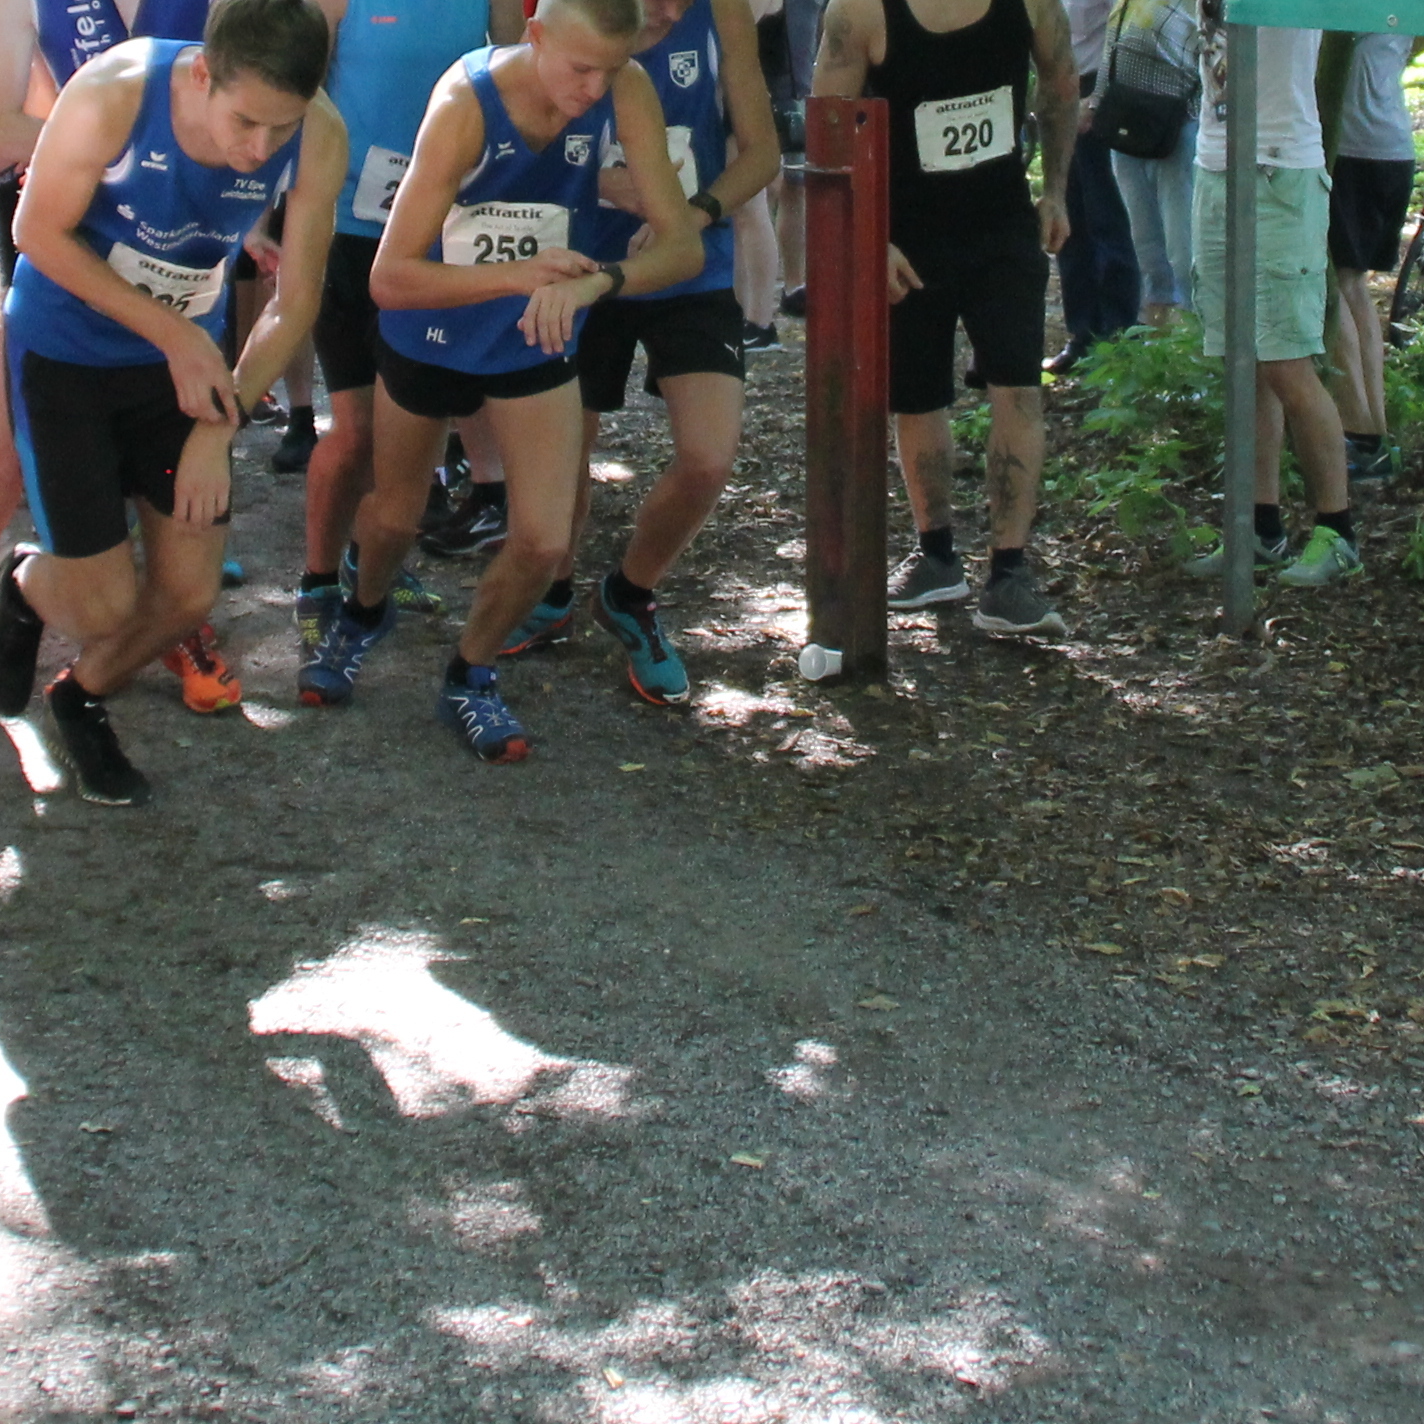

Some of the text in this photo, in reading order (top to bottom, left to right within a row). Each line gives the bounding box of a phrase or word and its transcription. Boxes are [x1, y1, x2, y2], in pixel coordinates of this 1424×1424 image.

[936, 95, 995, 114] attractic
[942, 118, 993, 157] 220
[473, 234, 539, 264] 259
[425, 327, 448, 345] HL
